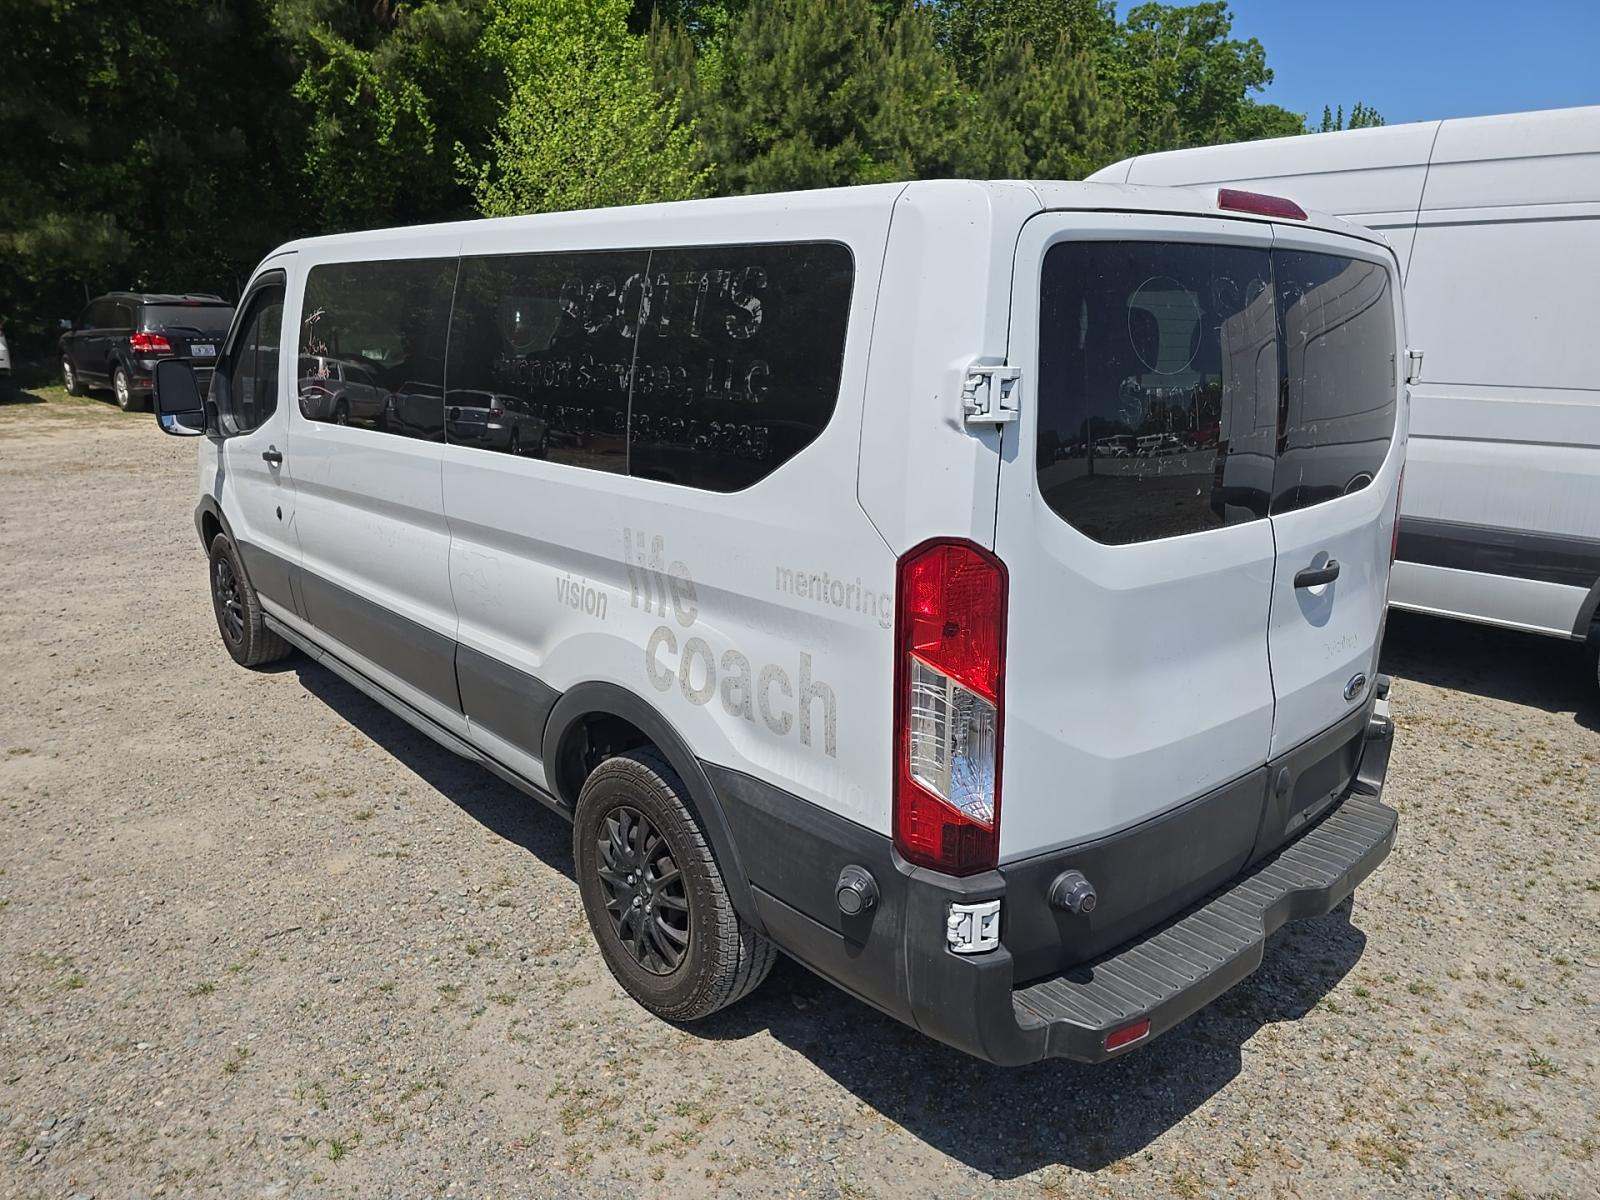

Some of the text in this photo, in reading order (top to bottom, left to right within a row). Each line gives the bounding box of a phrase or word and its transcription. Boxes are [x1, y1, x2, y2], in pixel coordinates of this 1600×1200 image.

[556, 575, 608, 620] vision
[623, 527, 699, 627] life
[775, 566, 893, 629] mentoring
[646, 625, 837, 760] coach
